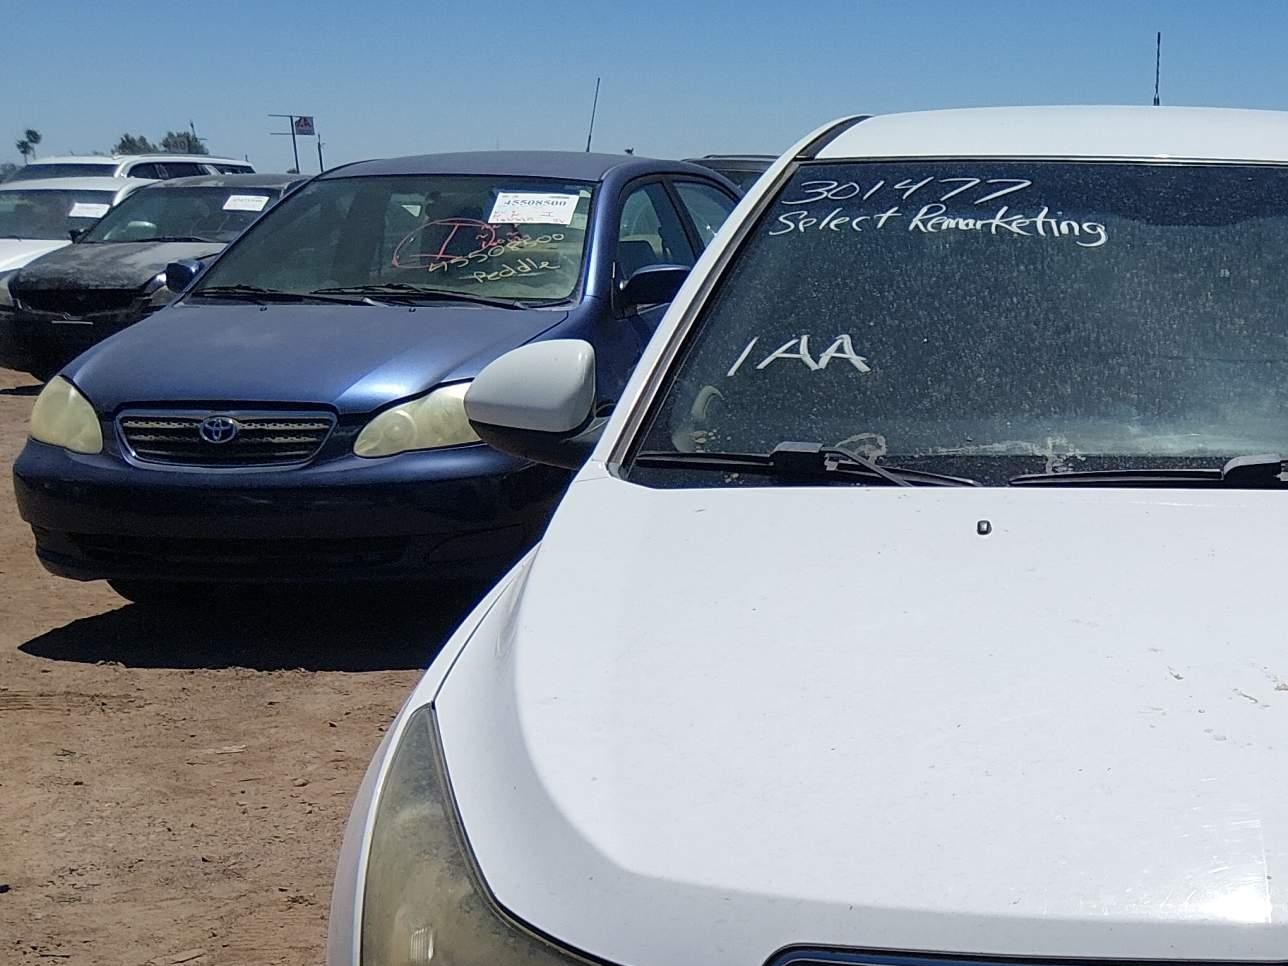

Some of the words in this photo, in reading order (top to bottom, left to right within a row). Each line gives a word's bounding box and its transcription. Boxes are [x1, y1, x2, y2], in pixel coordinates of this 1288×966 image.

[781, 176, 1033, 205] 301477
[769, 206, 902, 236] Select
[908, 203, 1108, 248] Remarketing
[726, 333, 873, 378] IAA
